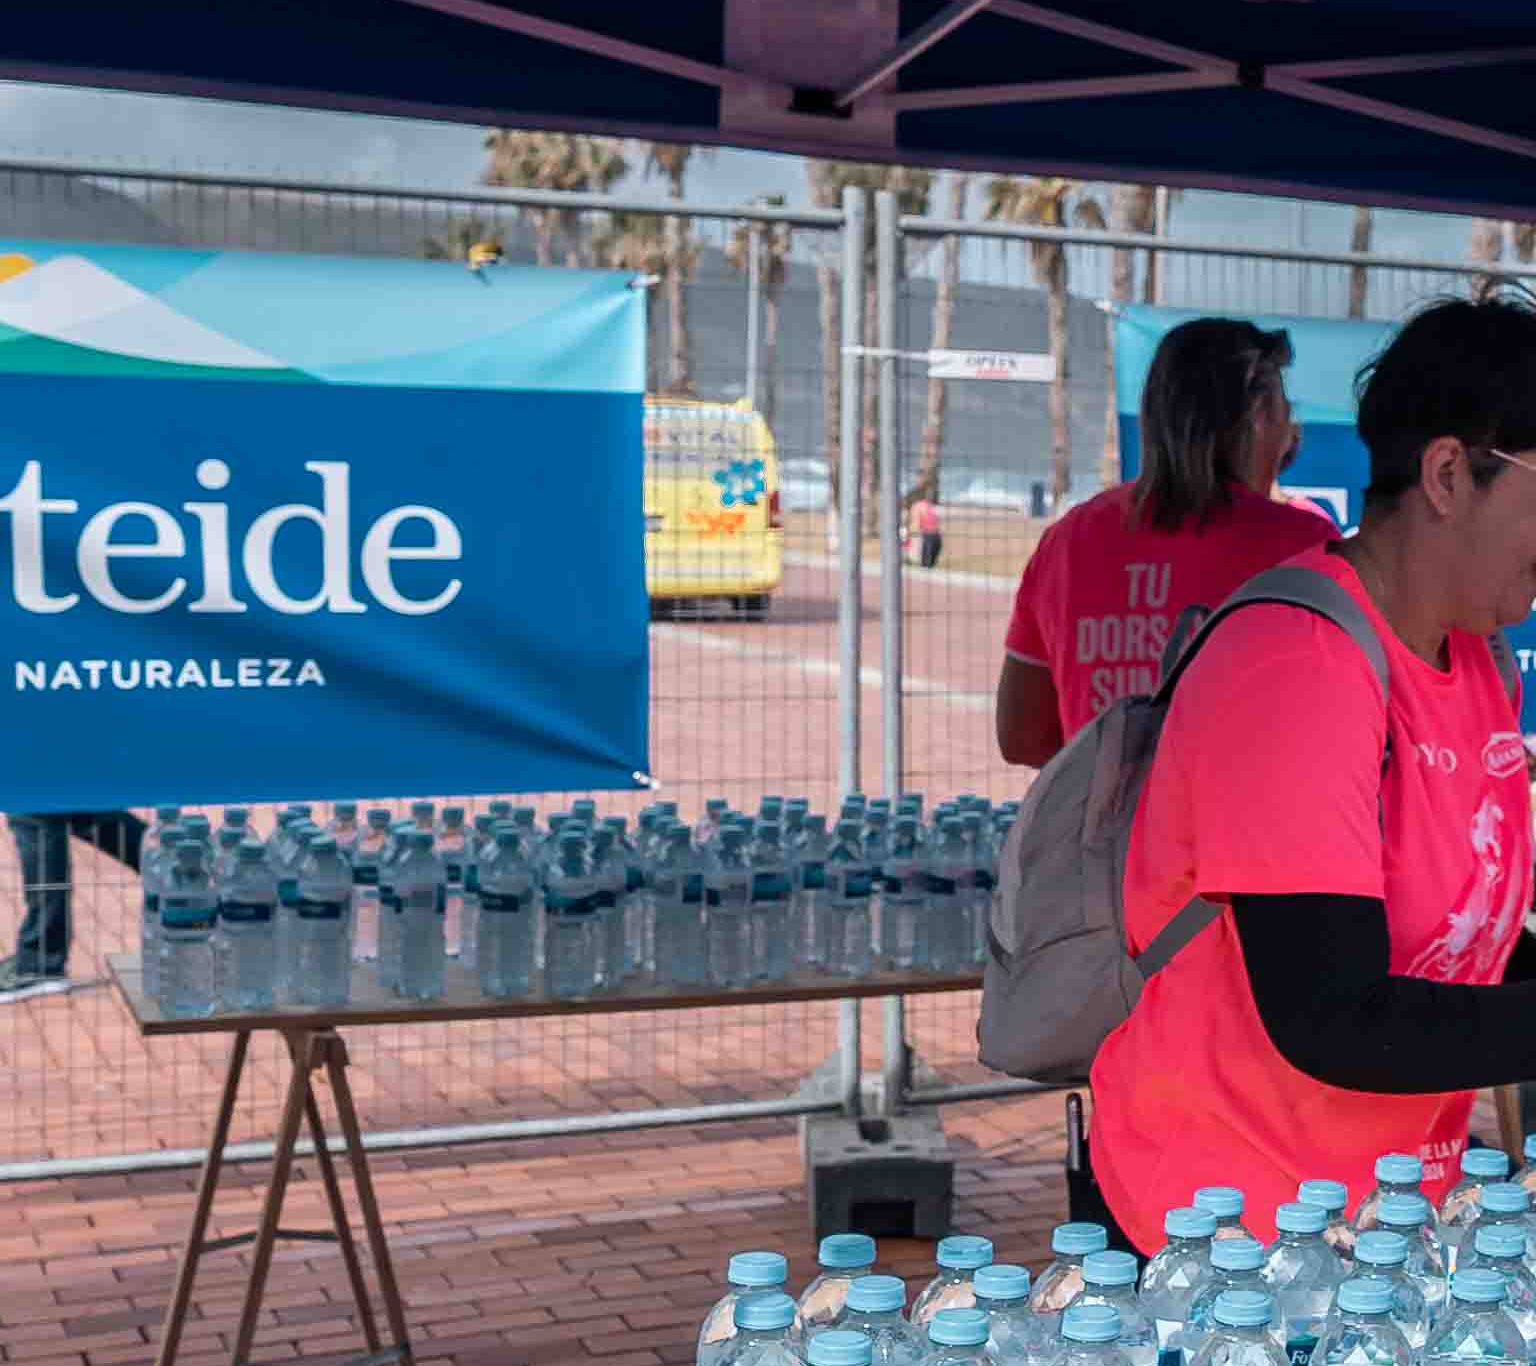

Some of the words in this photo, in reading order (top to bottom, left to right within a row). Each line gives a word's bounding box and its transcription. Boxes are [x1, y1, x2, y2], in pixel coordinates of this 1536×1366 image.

[1124, 563, 1171, 608] TU
[1077, 614, 1180, 664] DORS
[15, 658, 326, 691] NATURALEZA
